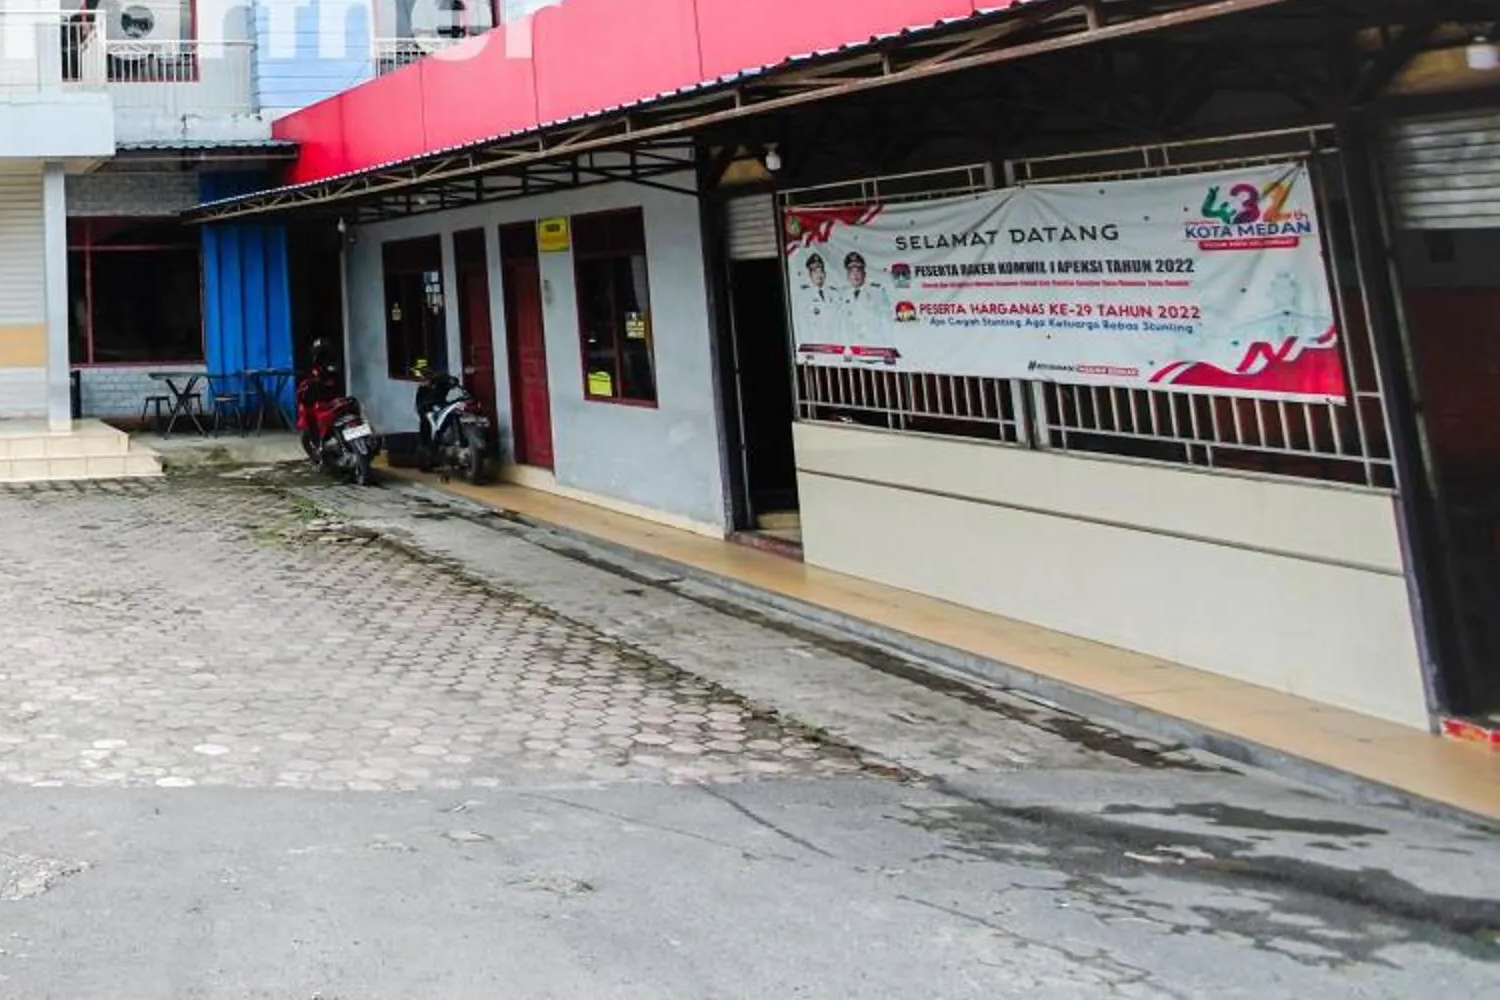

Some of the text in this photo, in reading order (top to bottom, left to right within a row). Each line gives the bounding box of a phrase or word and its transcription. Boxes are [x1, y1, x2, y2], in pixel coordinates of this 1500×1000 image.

[895, 223, 1120, 250] SELAMAT DATANG
[1185, 221, 1311, 239] KOTA MEDAN
[914, 263, 959, 277] PESERTA
[998, 261, 1048, 275] KOMWIL
[1057, 260, 1103, 274] APEKSI
[1105, 259, 1152, 273] TAHUN
[1155, 258, 1195, 273] 2022
[919, 303, 1201, 319] PESERTA HARGANAS KE-29 TAHUN 2022
[1048, 318, 1100, 331] Keluarga
[1102, 319, 1140, 332] Bebas
[1143, 321, 1194, 335] Stunting
